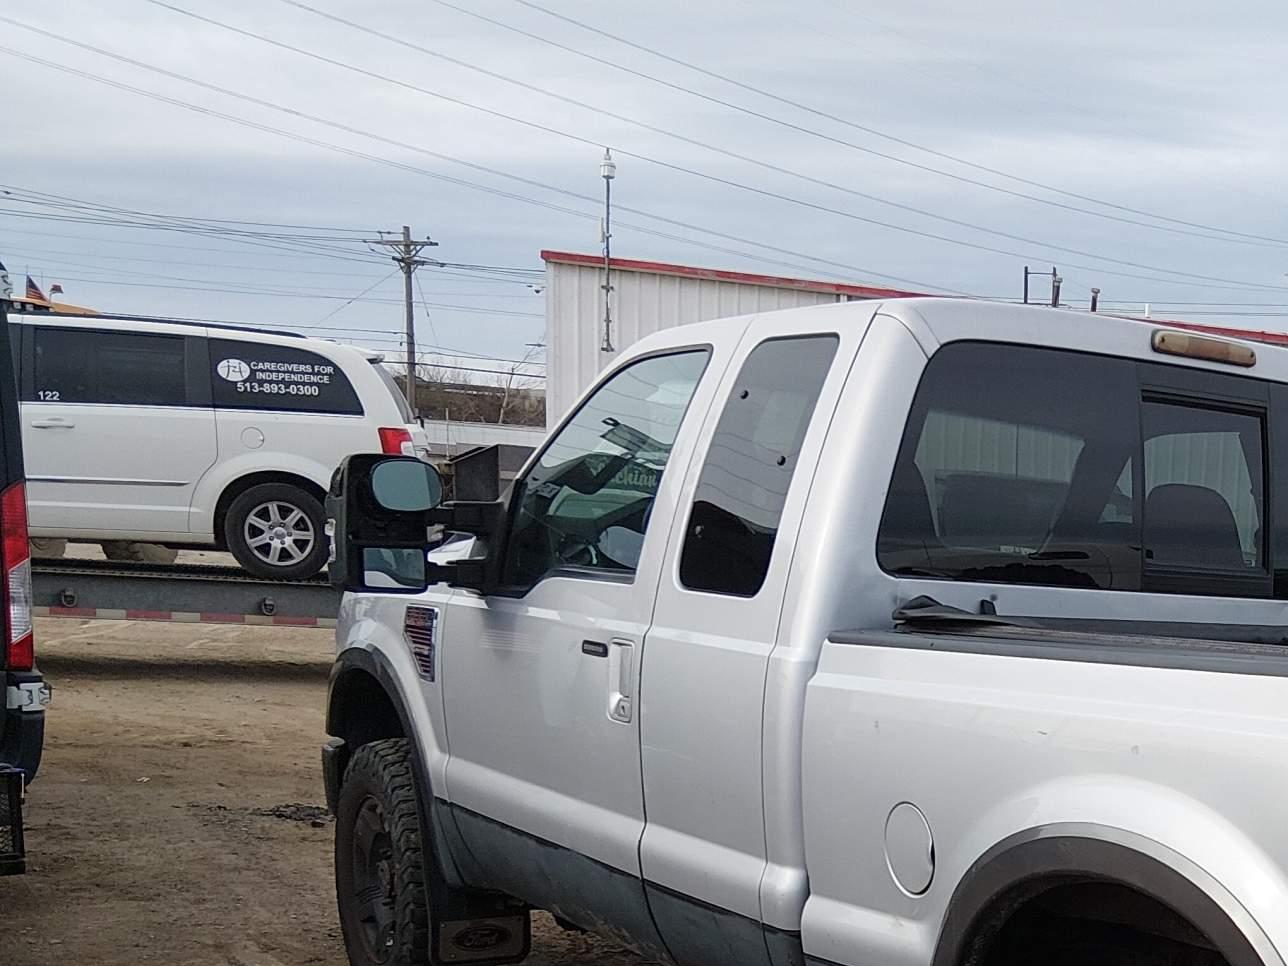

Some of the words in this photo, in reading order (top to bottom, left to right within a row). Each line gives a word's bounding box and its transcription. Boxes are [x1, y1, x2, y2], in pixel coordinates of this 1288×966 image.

[250, 361, 312, 373] CAREGIVERS
[314, 365, 335, 375] FOR
[256, 371, 331, 384] INDEPENDENCE
[237, 381, 319, 396] 513-893-0300
[38, 390, 60, 401] 122
